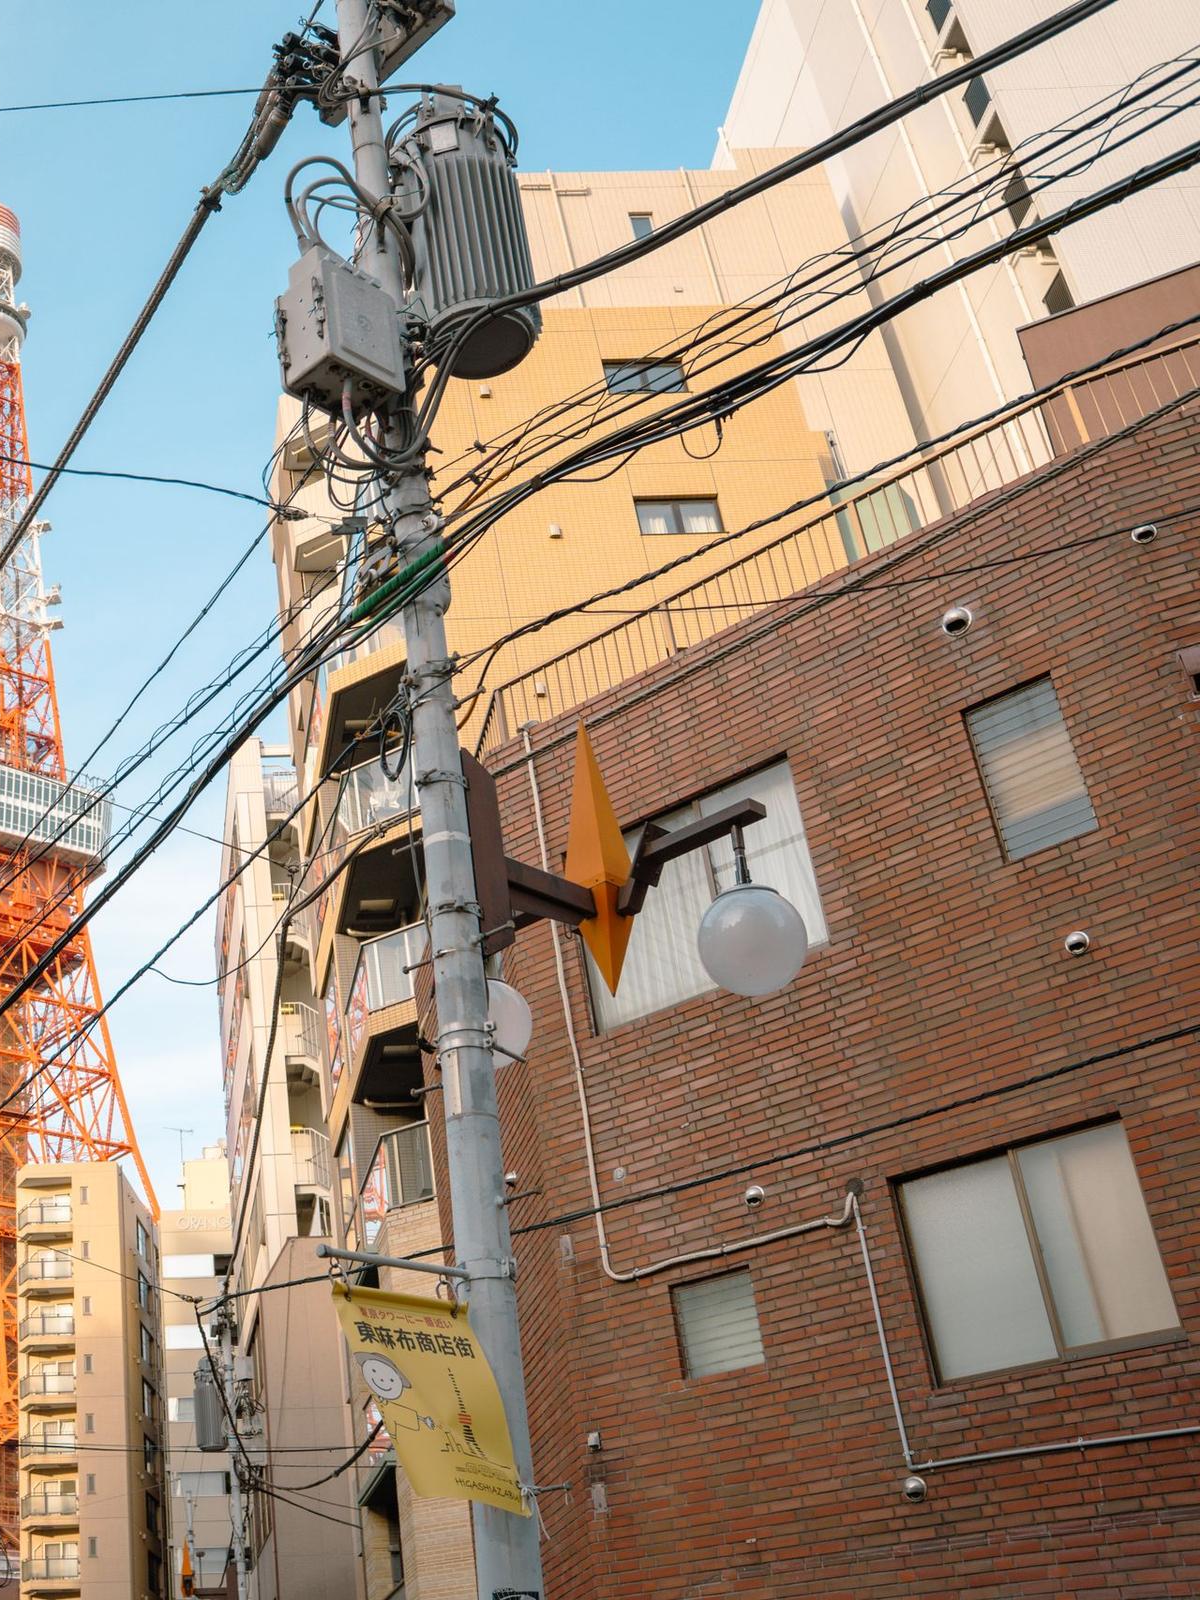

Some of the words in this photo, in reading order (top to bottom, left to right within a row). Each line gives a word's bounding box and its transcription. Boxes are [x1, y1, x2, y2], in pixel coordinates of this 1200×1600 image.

[354, 1321, 476, 1359] 東麻布商店街
